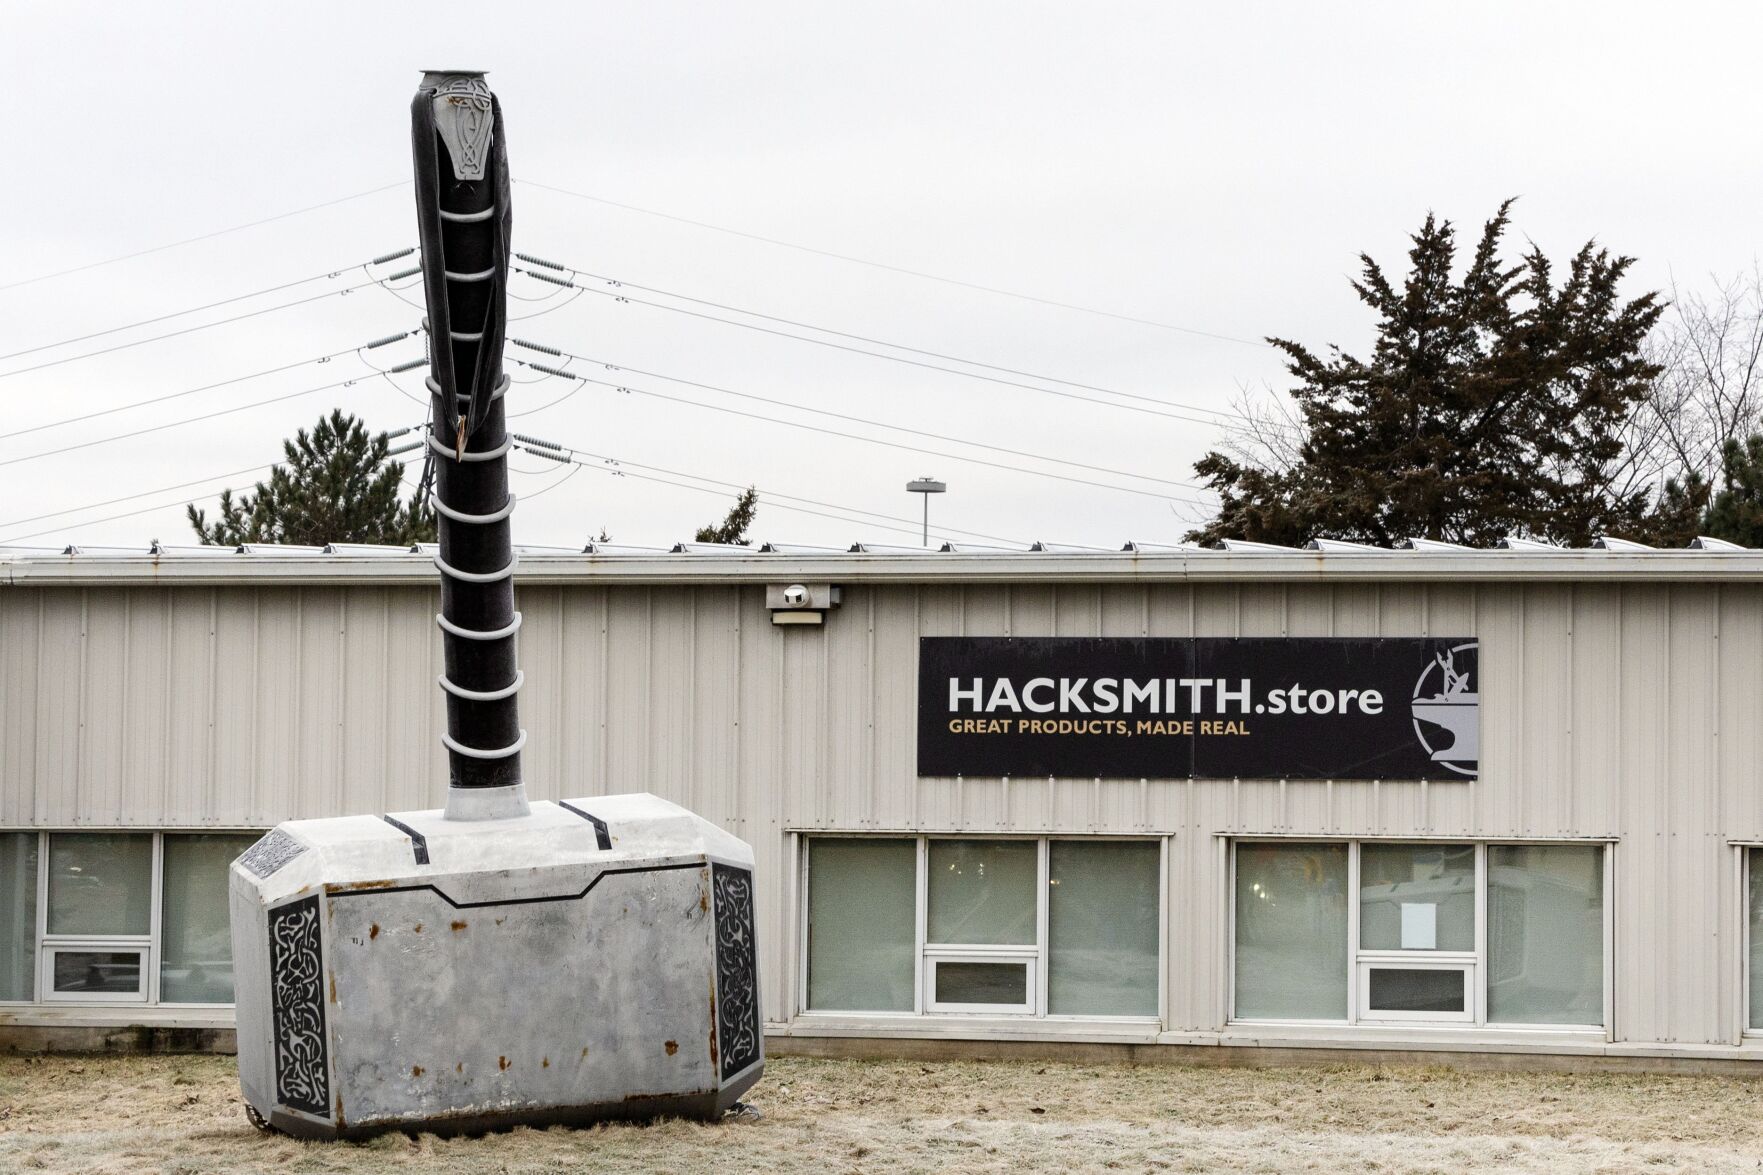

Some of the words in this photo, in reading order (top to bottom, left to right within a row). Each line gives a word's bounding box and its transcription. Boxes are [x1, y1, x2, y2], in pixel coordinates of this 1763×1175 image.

[948, 677, 1384, 714] HACKSMITH.store
[949, 719, 1013, 734] GREAT
[1018, 719, 1132, 738] PRODUCTS,
[1136, 720, 1194, 735] MADE
[1200, 721, 1251, 736] REAL
